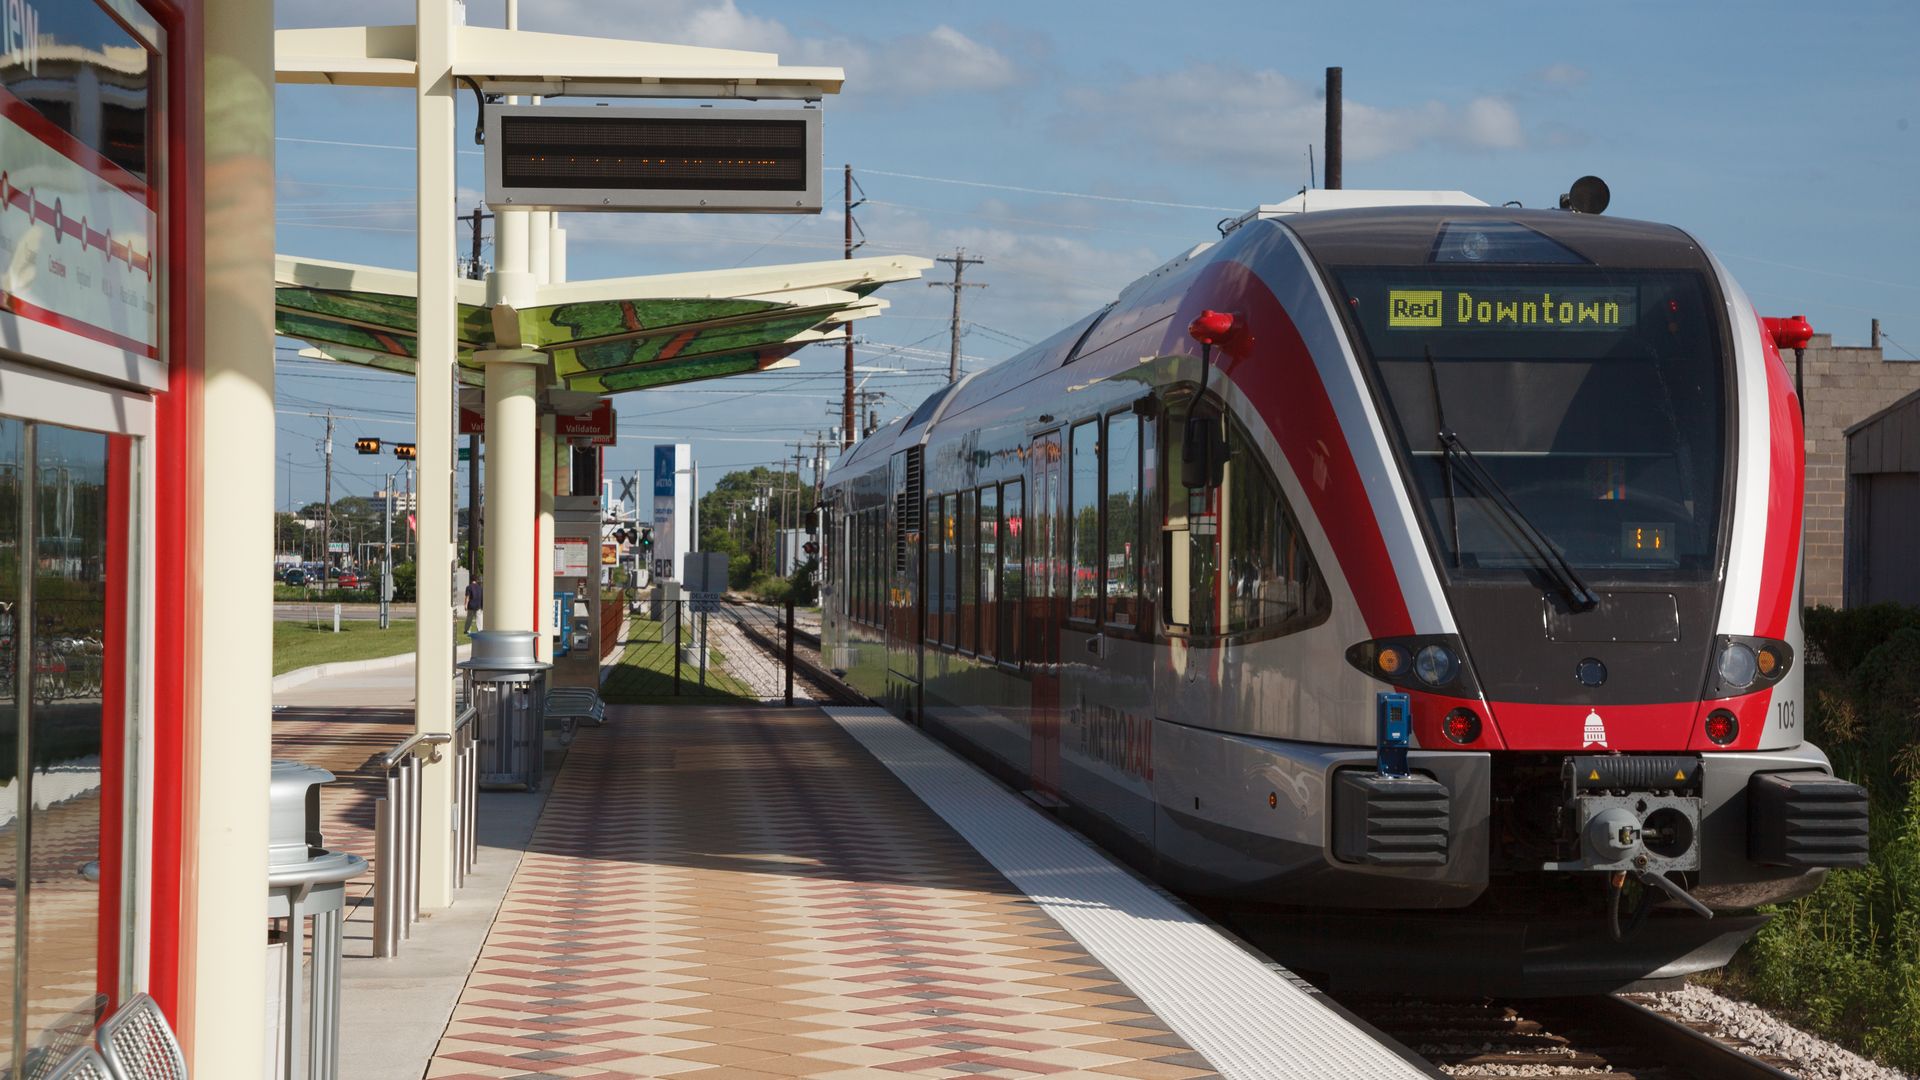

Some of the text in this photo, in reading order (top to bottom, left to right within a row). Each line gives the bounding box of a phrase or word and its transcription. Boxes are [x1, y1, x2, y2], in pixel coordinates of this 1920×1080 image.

[1393, 292, 1620, 324] Red Downtown
[565, 424, 601, 434] Validator
[1777, 699, 1795, 730] 103
[1088, 704, 1154, 782] METRORAIL
